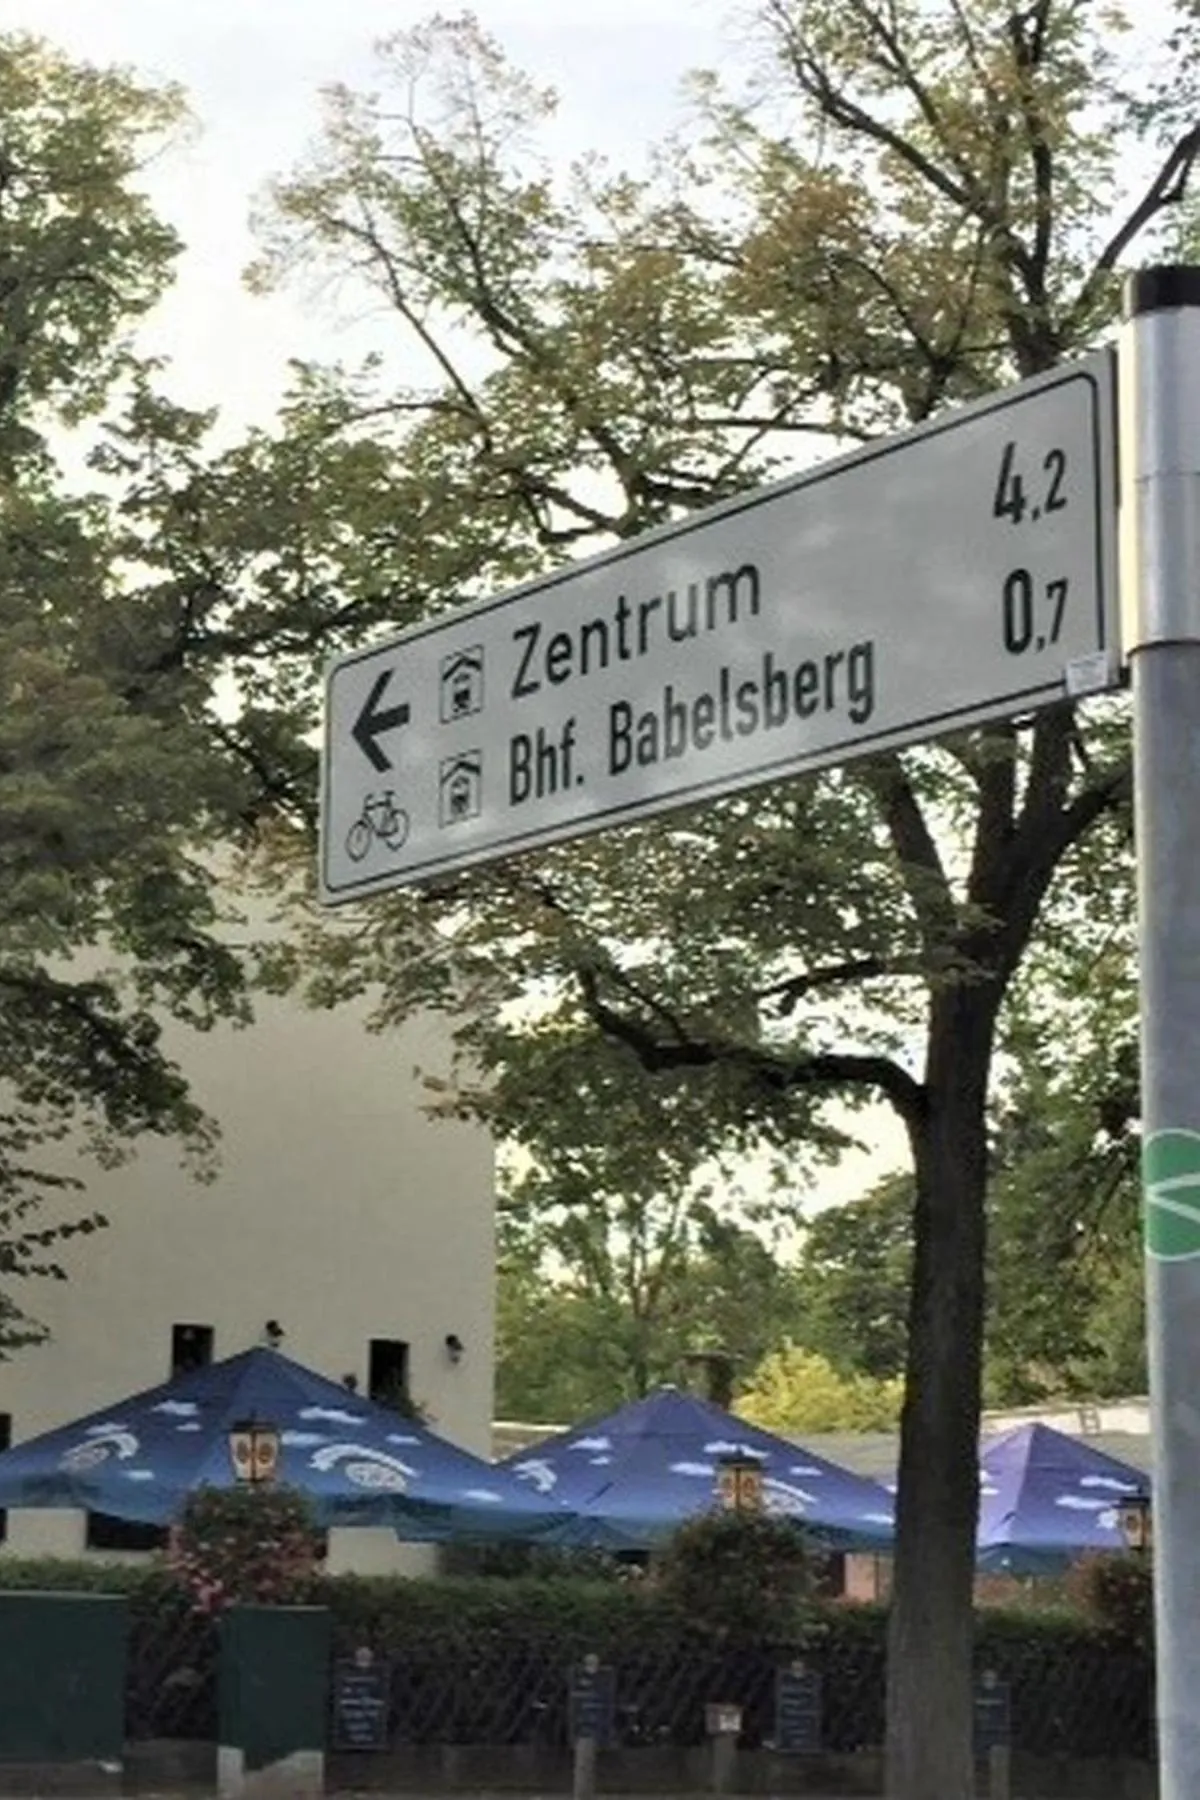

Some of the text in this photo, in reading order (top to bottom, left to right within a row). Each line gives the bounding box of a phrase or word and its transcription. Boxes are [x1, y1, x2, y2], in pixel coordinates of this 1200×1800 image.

[509, 567, 1068, 806] Bhf. Babelsberg 0,7
[510, 440, 1068, 699] Zentrum 4,2
